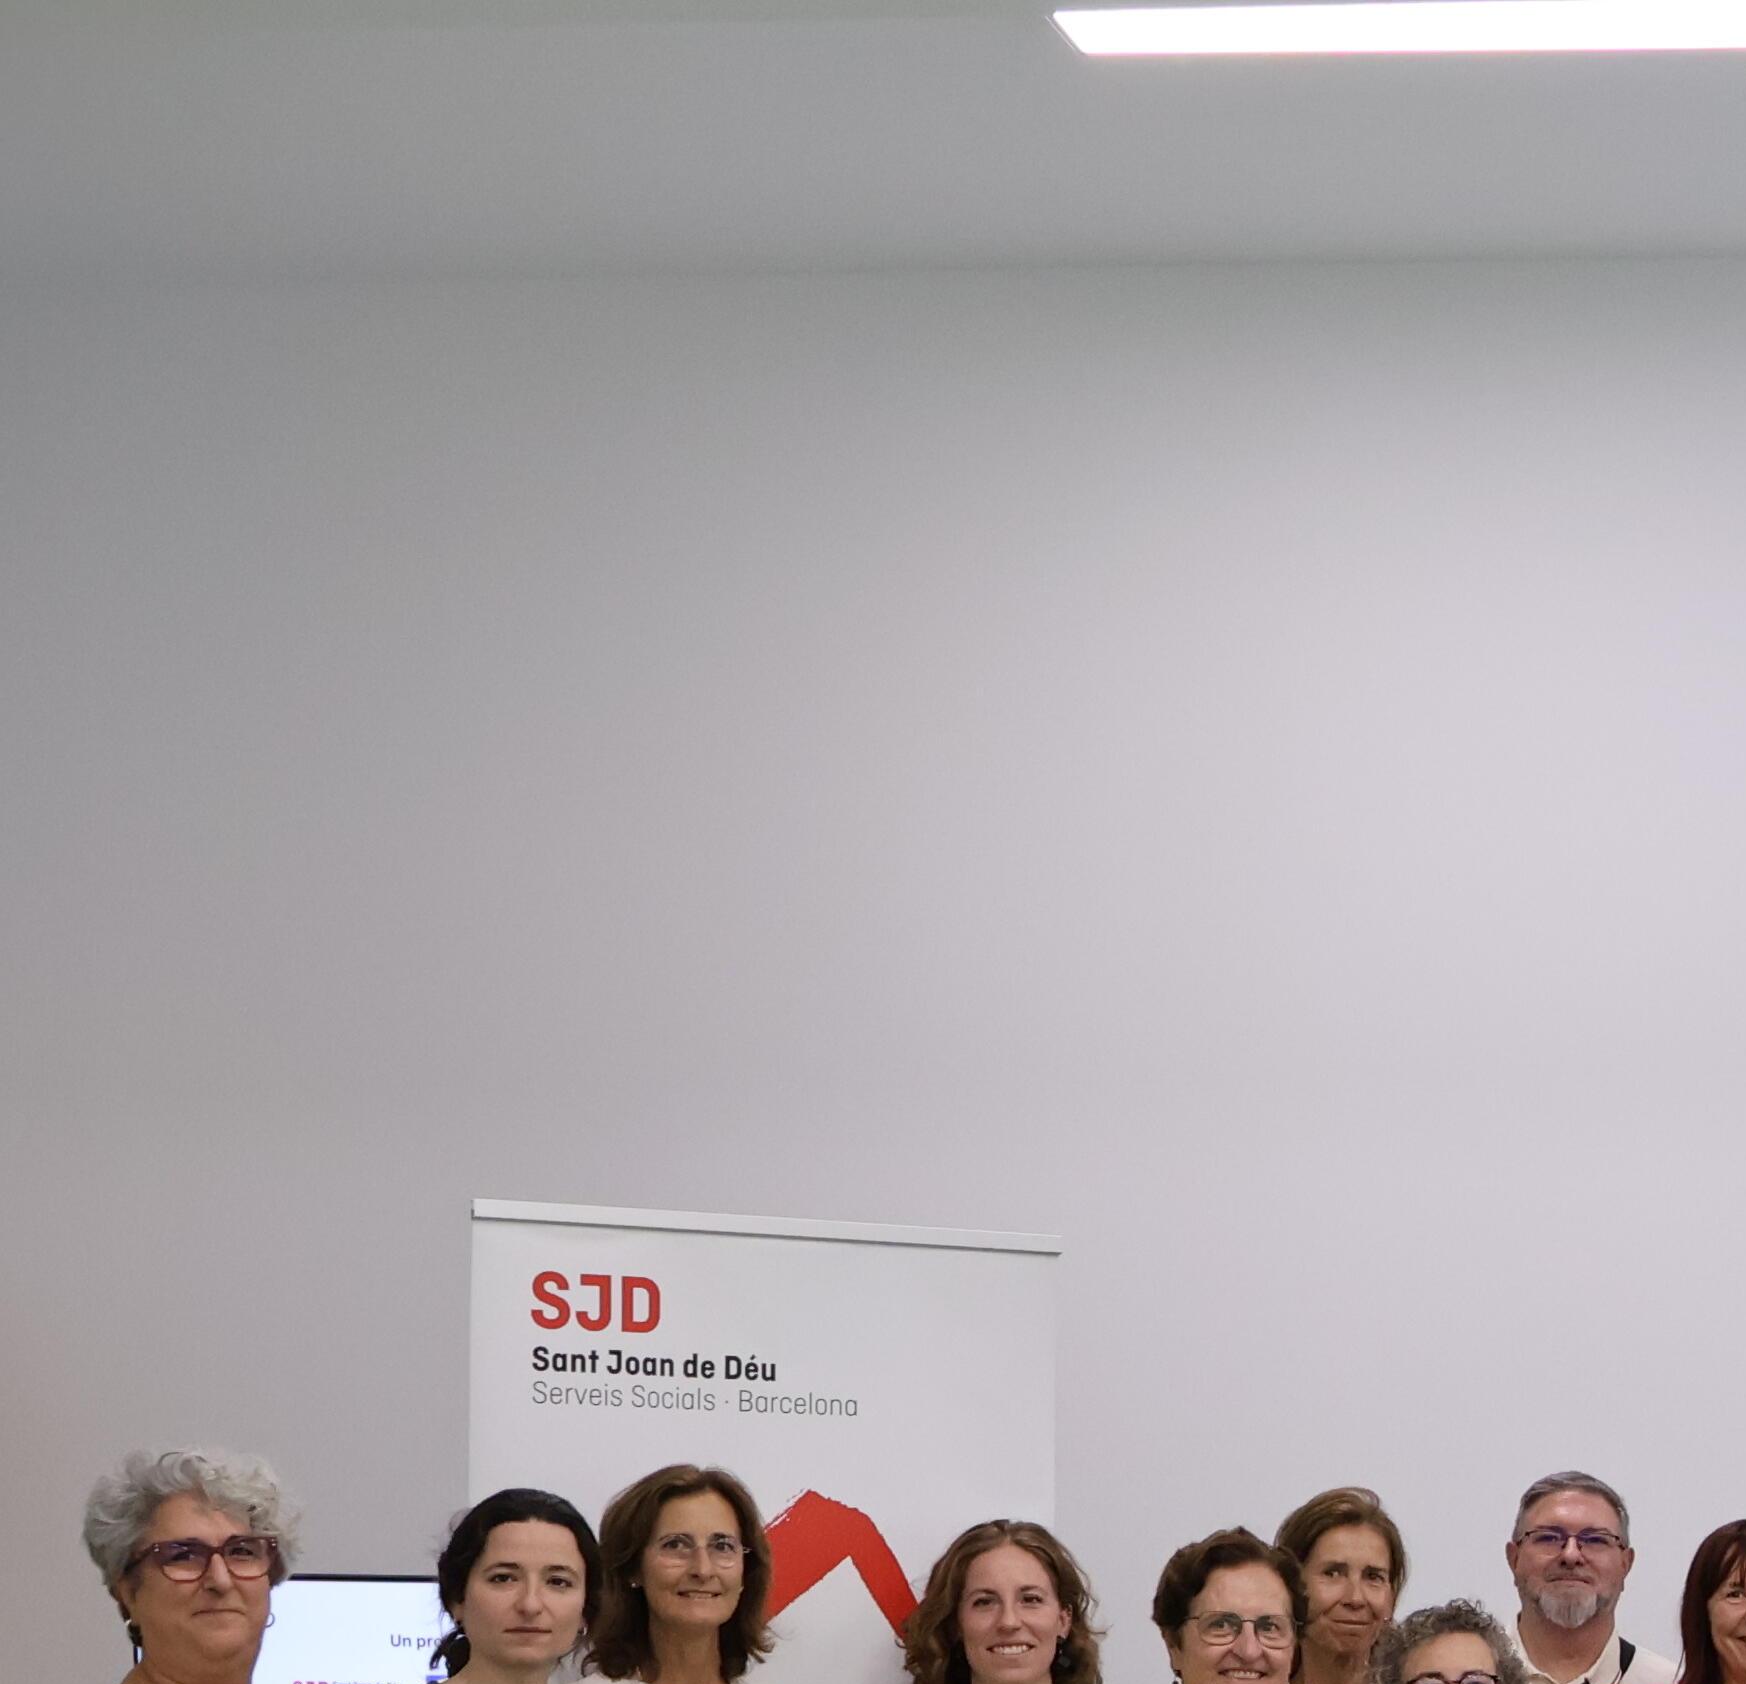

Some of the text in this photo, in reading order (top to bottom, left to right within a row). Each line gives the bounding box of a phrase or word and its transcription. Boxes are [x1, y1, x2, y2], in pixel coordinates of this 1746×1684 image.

[531, 1270, 661, 1333] SJD
[532, 1346, 777, 1381] Sant Joan de Déu
[532, 1381, 858, 1416] Serveis Socials Barcelona
[390, 1633, 412, 1648] Un
